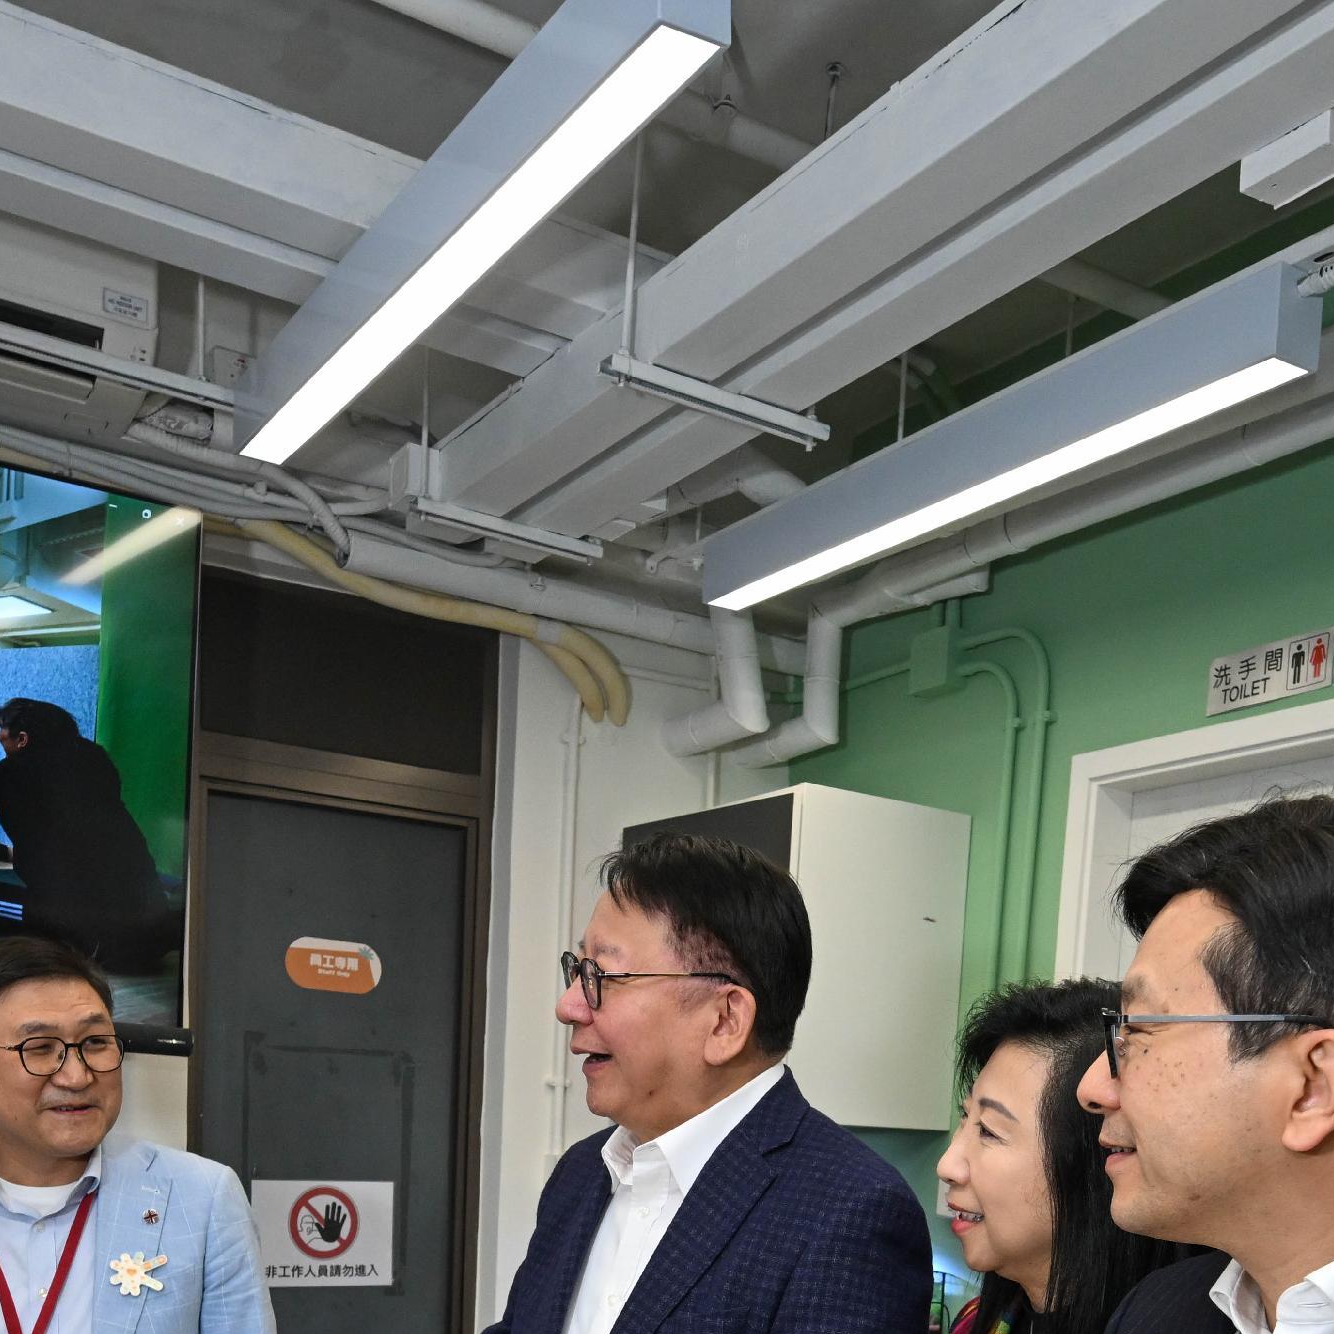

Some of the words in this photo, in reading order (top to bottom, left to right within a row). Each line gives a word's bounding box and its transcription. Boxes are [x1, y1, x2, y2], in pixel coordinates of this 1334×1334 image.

[1213, 648, 1283, 688] 洗手間
[1222, 677, 1271, 704] TOILET
[265, 1264, 379, 1279] 非工作人員請勿進入
